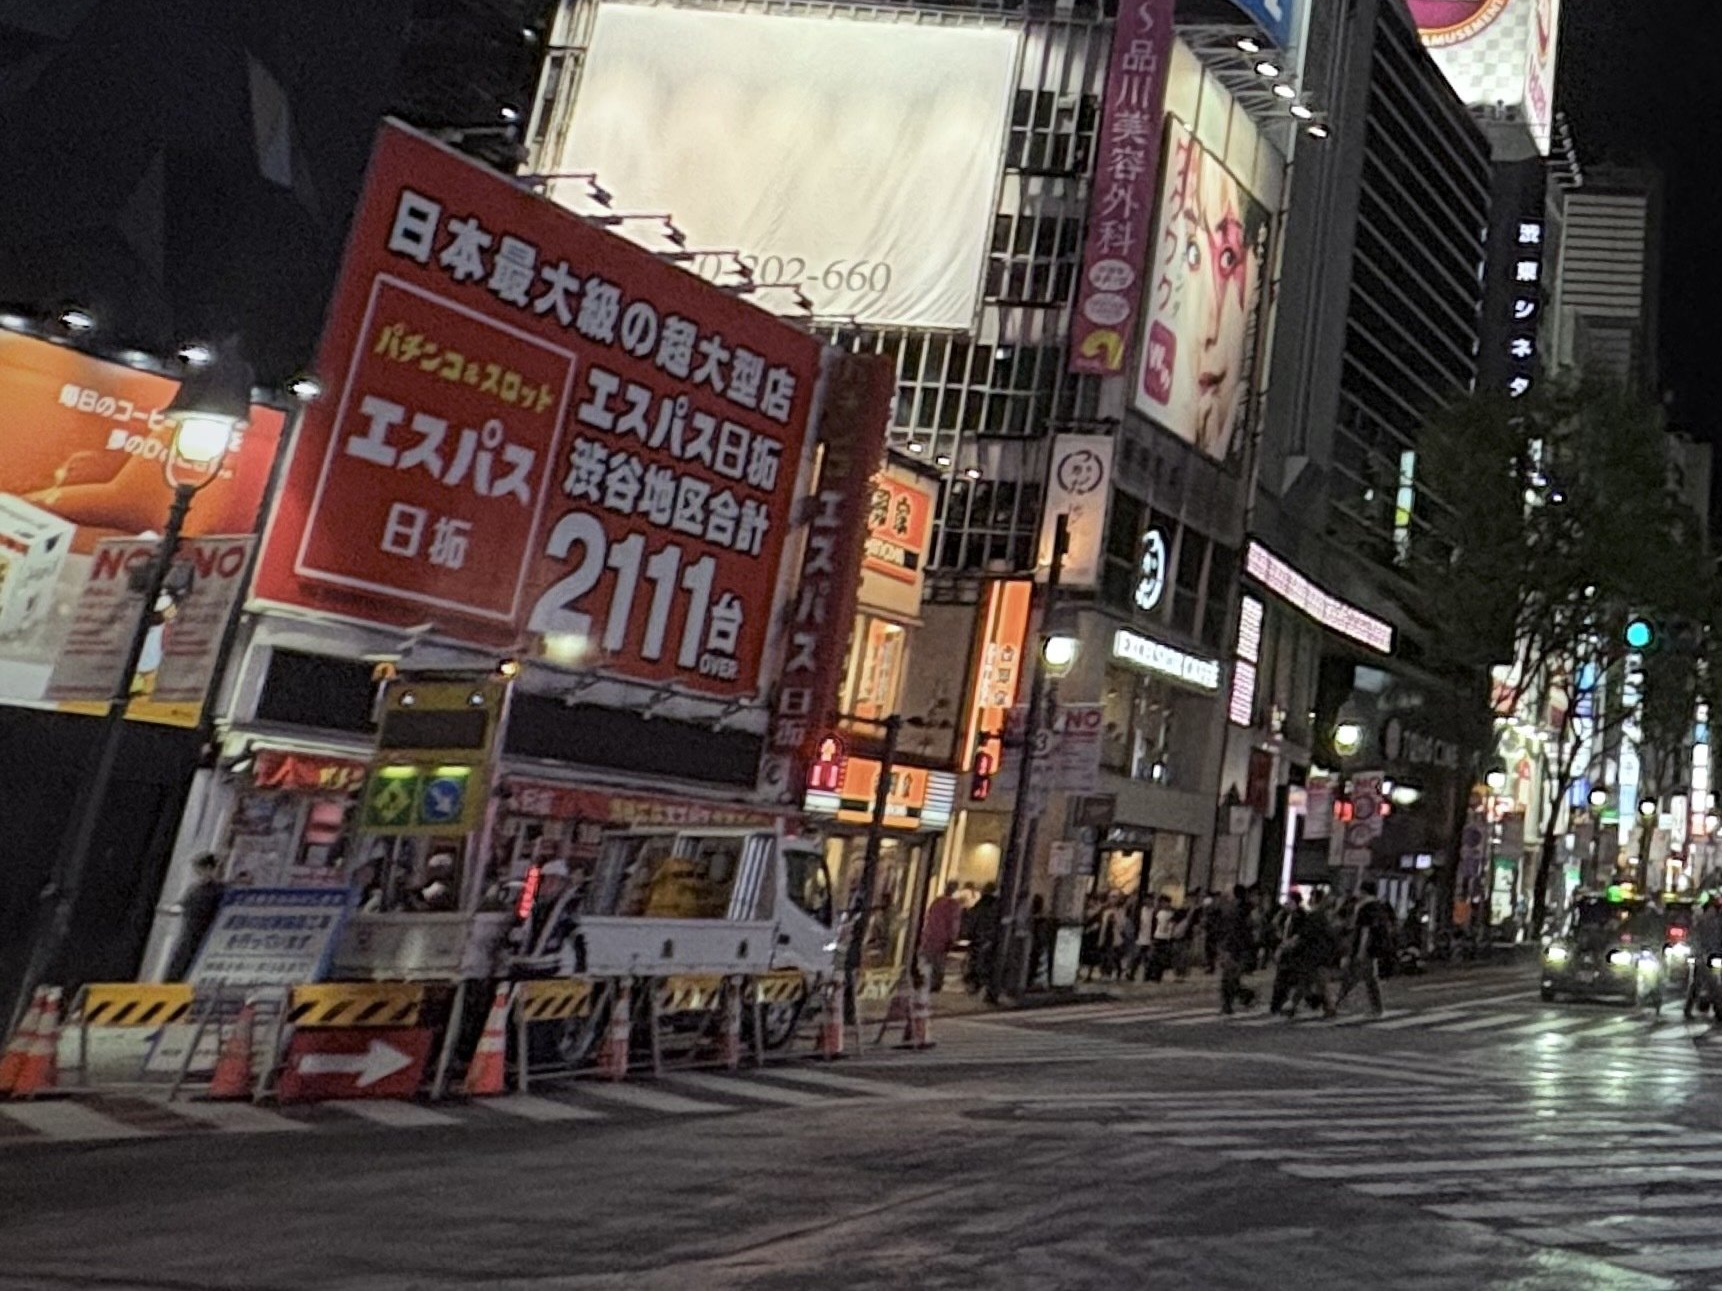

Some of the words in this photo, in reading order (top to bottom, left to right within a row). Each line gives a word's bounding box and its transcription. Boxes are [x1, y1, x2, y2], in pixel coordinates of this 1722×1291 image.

[1098, 39, 1158, 257] 品川美容外科
[387, 189, 797, 424] 日本最大級の超大型店
[346, 395, 537, 505] エスパス
[563, 438, 770, 555] 渋谷地区合計
[699, 654, 739, 679] OVER
